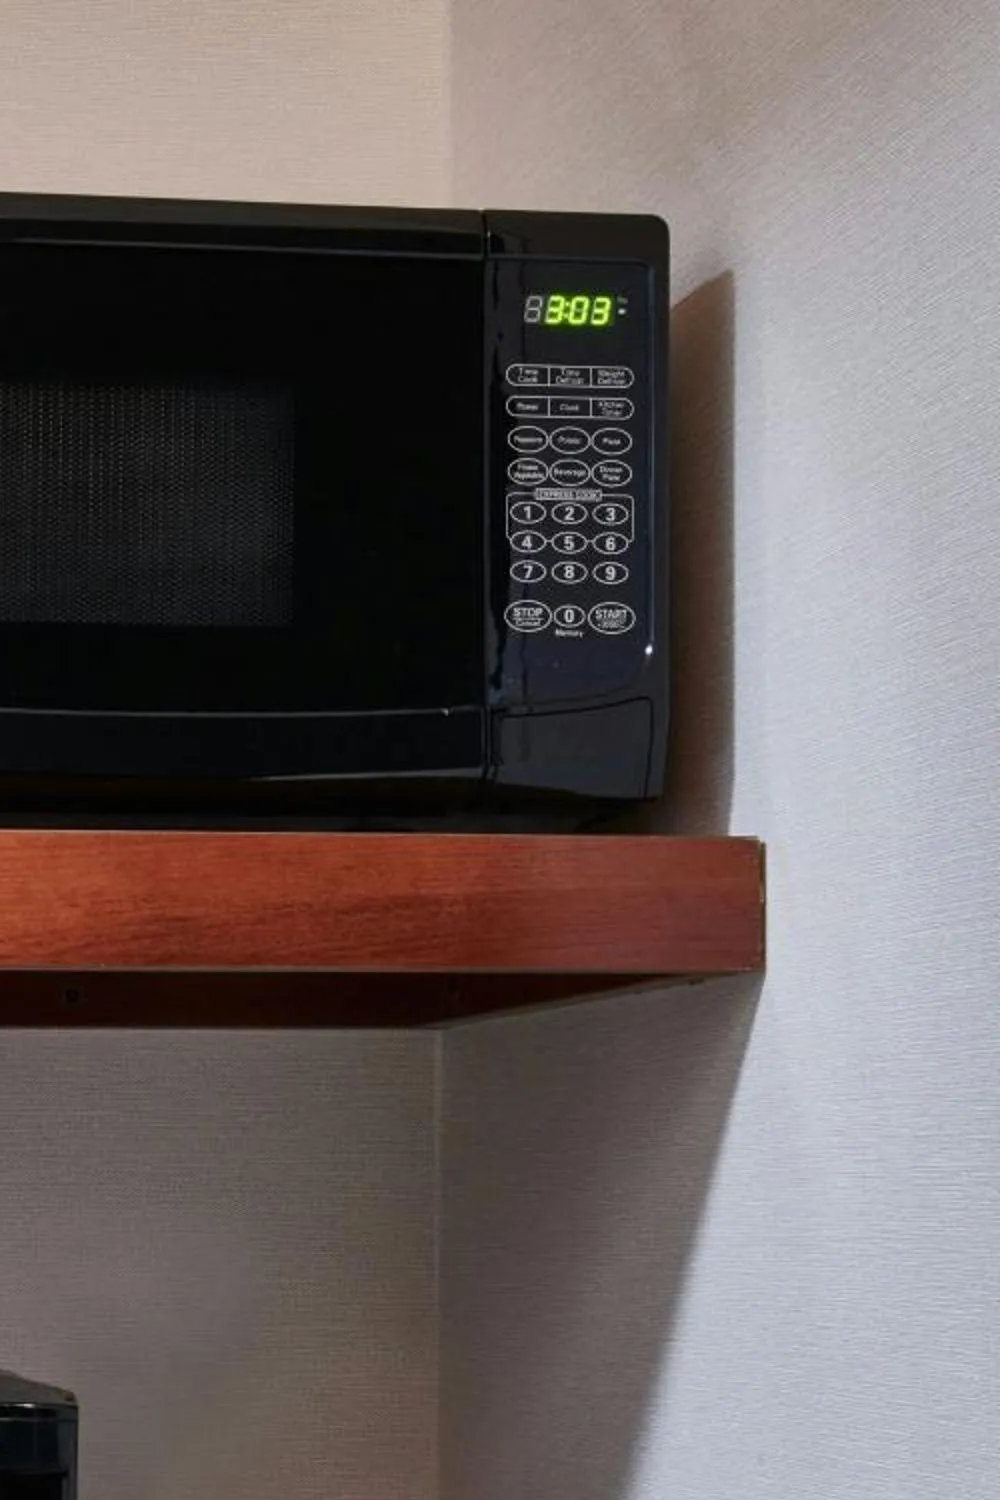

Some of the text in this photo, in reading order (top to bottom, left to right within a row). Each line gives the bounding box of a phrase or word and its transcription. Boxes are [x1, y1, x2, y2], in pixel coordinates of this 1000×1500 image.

[523, 506, 532, 519] 1
[564, 507, 575, 521] 2
[606, 508, 616, 521] 3
[521, 536, 533, 550] 4
[564, 537, 575, 550] 5
[605, 538, 616, 551] 6
[522, 565, 533, 579] 7
[564, 565, 575, 579] 8
[605, 566, 616, 581] 9
[564, 609, 575, 623] 0
